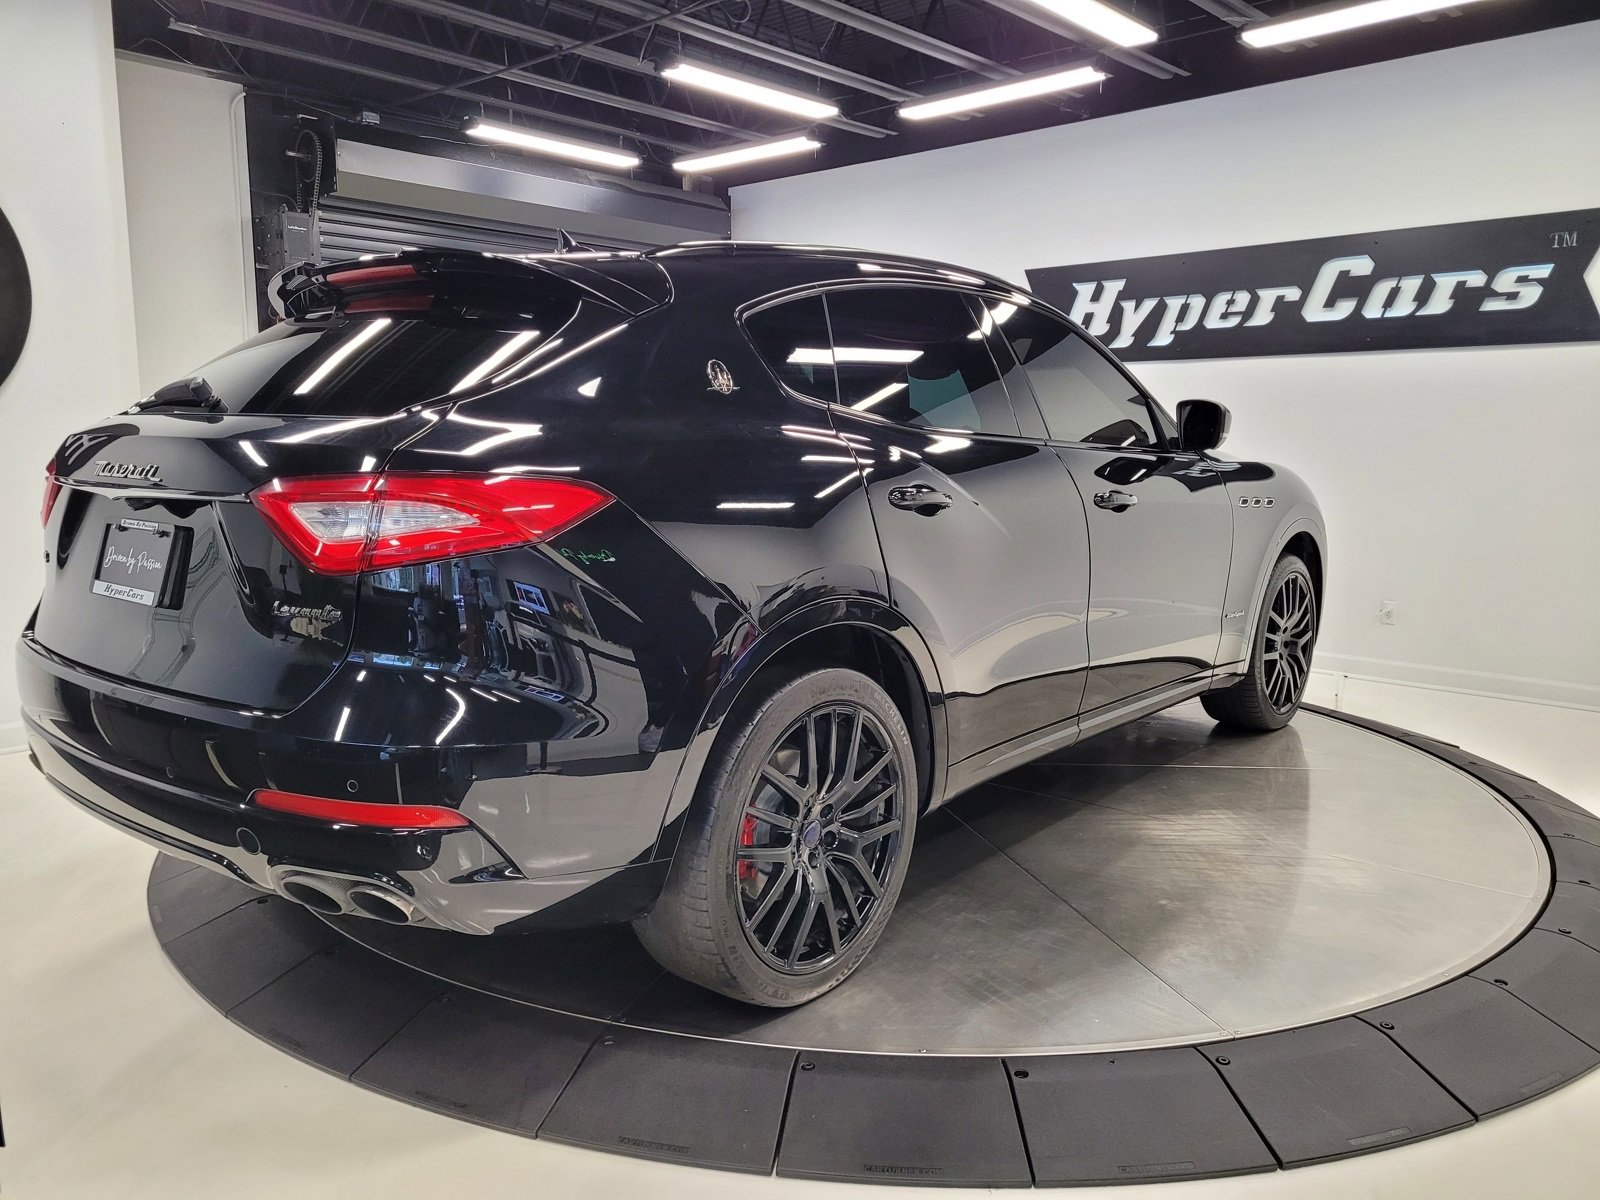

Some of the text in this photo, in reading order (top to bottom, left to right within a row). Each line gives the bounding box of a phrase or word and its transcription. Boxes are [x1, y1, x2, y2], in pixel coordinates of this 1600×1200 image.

[1069, 230, 1579, 349] HyperCars TM
[103, 583, 145, 601] HyperCars
[873, 692, 910, 746] MICHELIN
